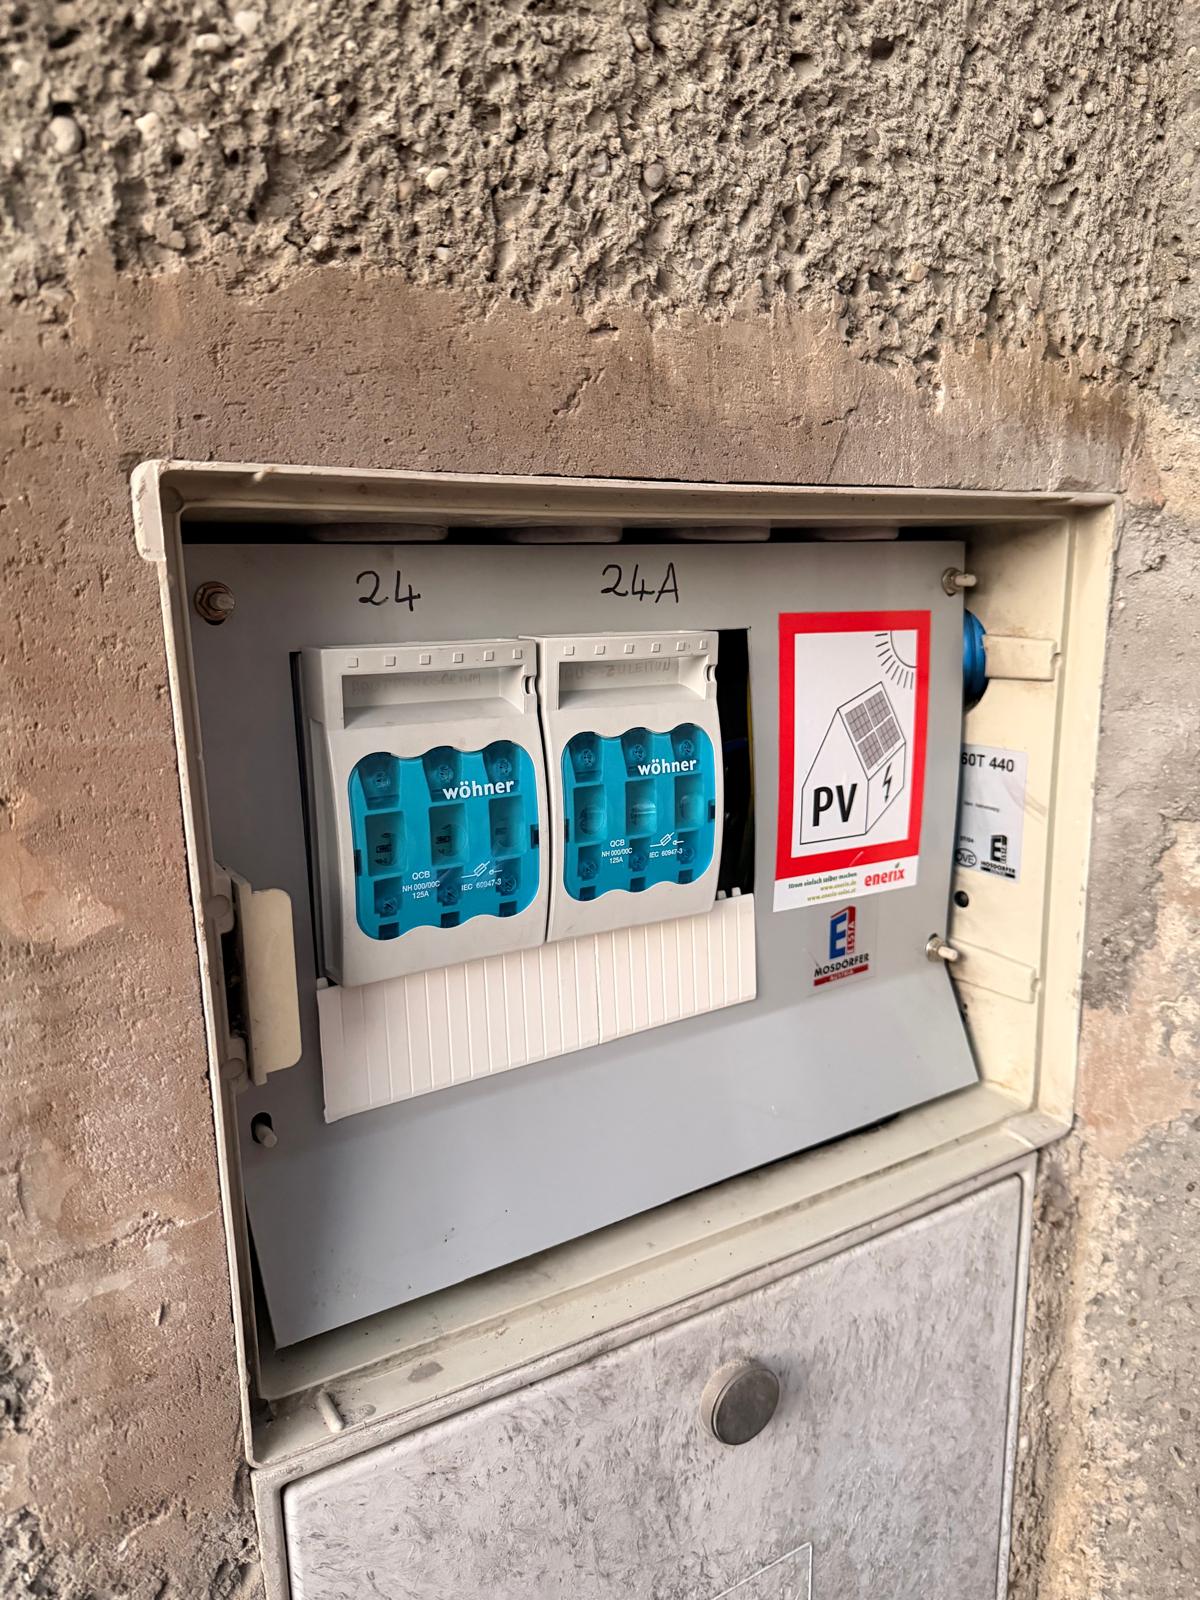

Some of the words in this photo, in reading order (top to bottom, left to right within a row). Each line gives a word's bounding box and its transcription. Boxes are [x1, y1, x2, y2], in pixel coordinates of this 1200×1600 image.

[600, 561, 679, 604] 24A
[356, 570, 421, 612] 24
[637, 759, 697, 776] wöhner
[989, 756, 1015, 773] 440
[442, 779, 515, 800] wöhner
[812, 783, 858, 827] PV
[610, 838, 625, 848] QCB
[601, 850, 611, 858] NH
[611, 847, 633, 857] 000/00C
[609, 856, 624, 864] 125A
[649, 850, 659, 859] IEC
[412, 870, 431, 881] QCB
[864, 862, 905, 887] enerix
[402, 883, 412, 893] NH
[413, 880, 441, 891] 000/00C
[461, 882, 473, 892] IEC
[476, 878, 502, 889] 60947-3
[412, 891, 430, 899] 125A
[813, 952, 870, 977] MOSDORFER
